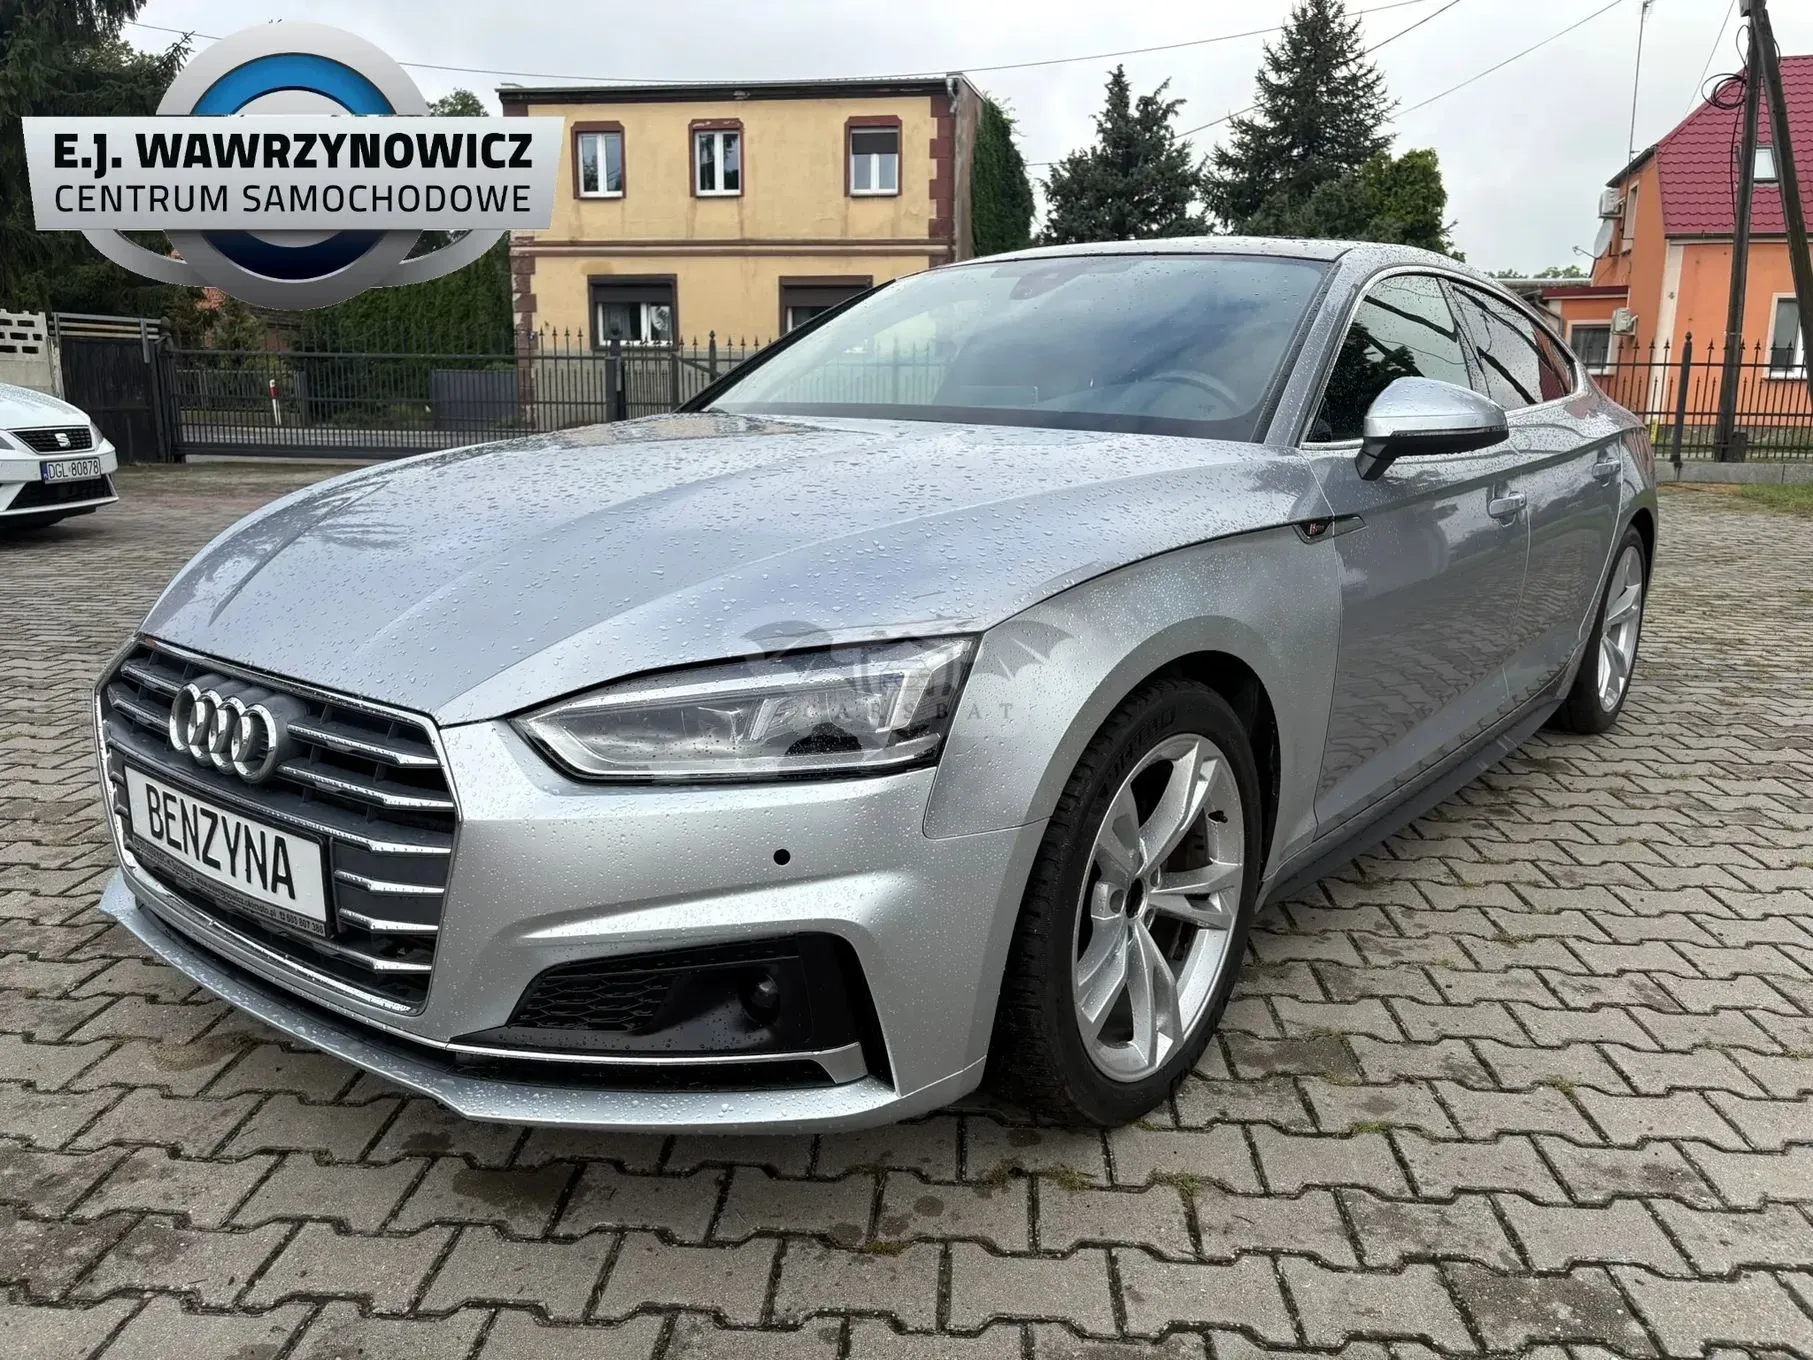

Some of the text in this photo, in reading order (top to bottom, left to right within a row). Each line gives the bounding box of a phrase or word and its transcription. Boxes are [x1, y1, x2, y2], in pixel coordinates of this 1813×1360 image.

[48, 460, 99, 479] DGL 80878
[146, 783, 296, 900] BENZYNA
